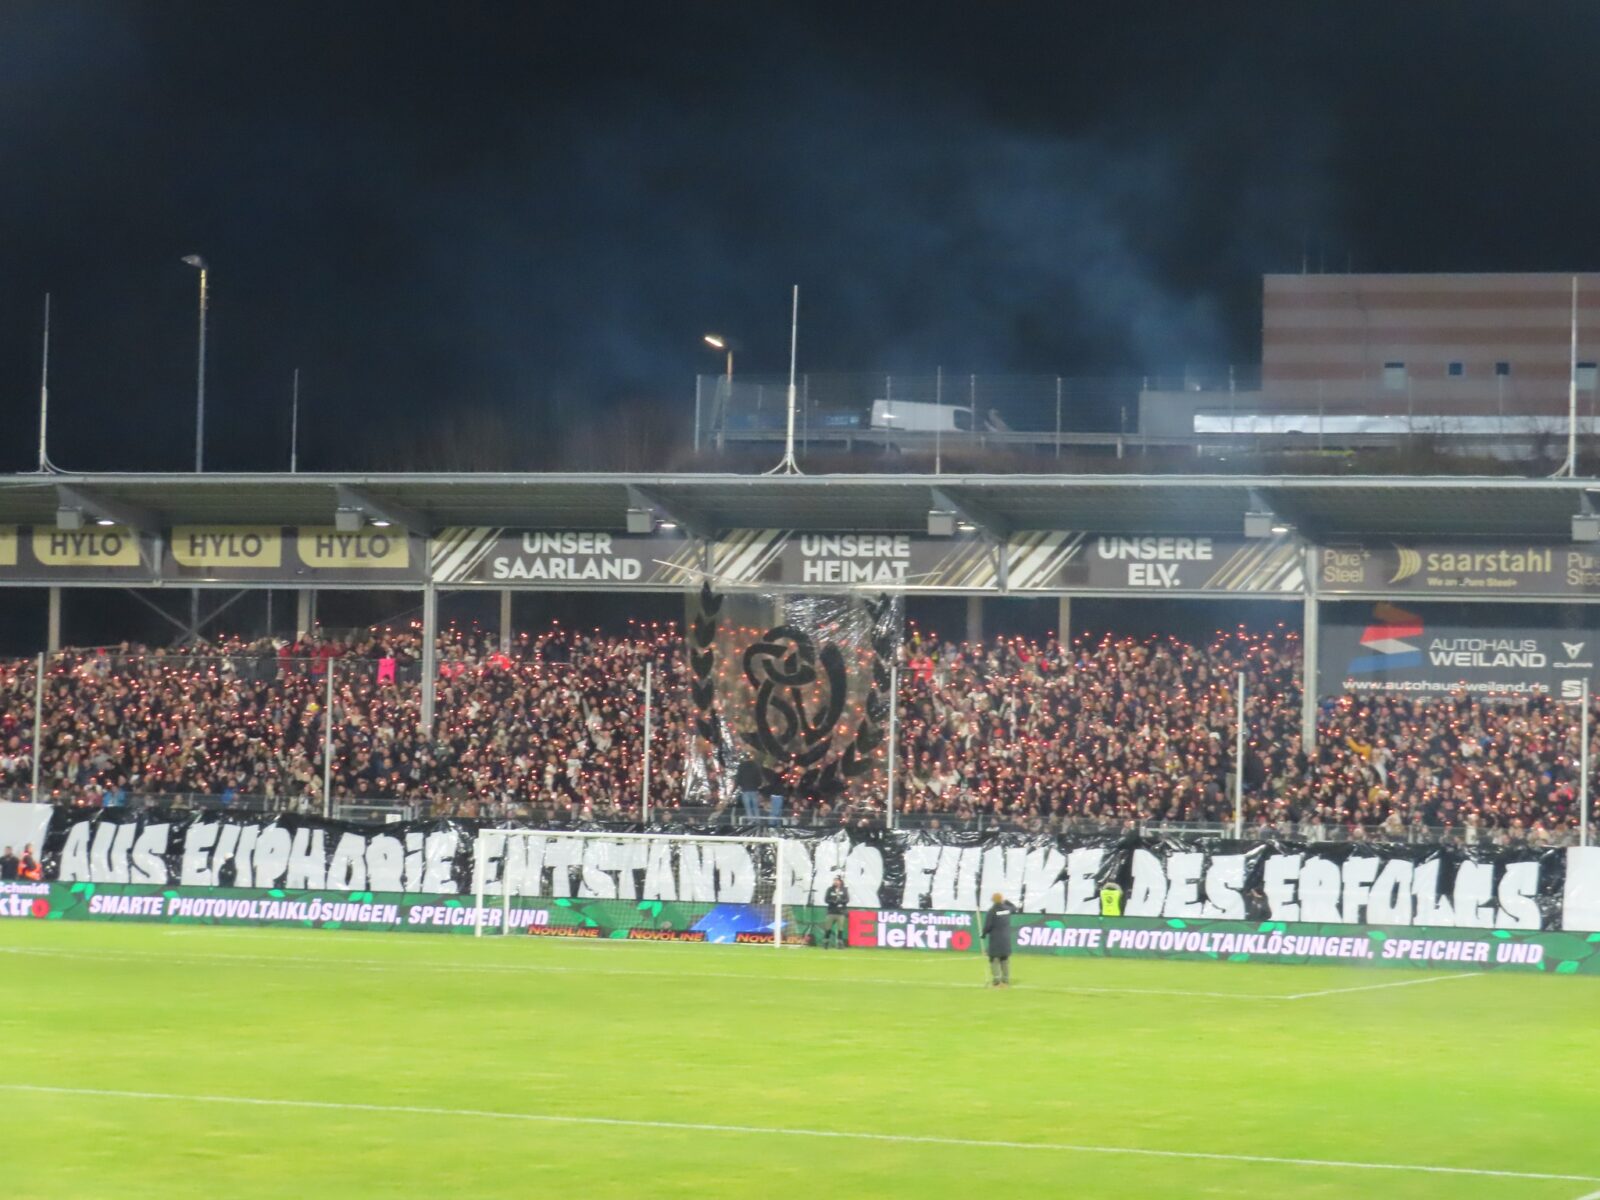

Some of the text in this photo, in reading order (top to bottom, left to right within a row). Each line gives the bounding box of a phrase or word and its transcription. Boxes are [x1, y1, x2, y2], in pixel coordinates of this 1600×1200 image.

[50, 533, 122, 556] HYLO
[190, 534, 263, 558] HYLO
[316, 534, 390, 559] HYLO
[523, 532, 612, 554] UNSER
[801, 535, 910, 557] UNSERE
[1098, 537, 1213, 560] UNSERE
[493, 557, 641, 580] SAARLAND
[803, 560, 910, 582] HEIMAT
[1427, 549, 1550, 572] saarstahl
[1128, 563, 1180, 588] ELV.
[1323, 566, 1364, 582] Steel
[1429, 639, 1537, 651] AUTOHAUS
[1429, 652, 1546, 668] WEILAND
[1343, 680, 1549, 693] www.autohaus-weiland.de
[58, 820, 169, 885] AUS
[470, 834, 756, 903] ENTSTAND
[902, 845, 1103, 914] FUNKE
[1124, 849, 1246, 920] DES
[1264, 853, 1540, 930] ERFOLGS
[90, 895, 163, 915] SMARTE
[408, 905, 502, 927] SPEICHER
[508, 908, 548, 927] UND
[878, 911, 971, 925] Udo Schmidt
[848, 909, 971, 951] Elektro
[1017, 926, 1102, 947] SMARTE
[1382, 939, 1490, 961] SPEICHER
[1496, 942, 1543, 964] UND
